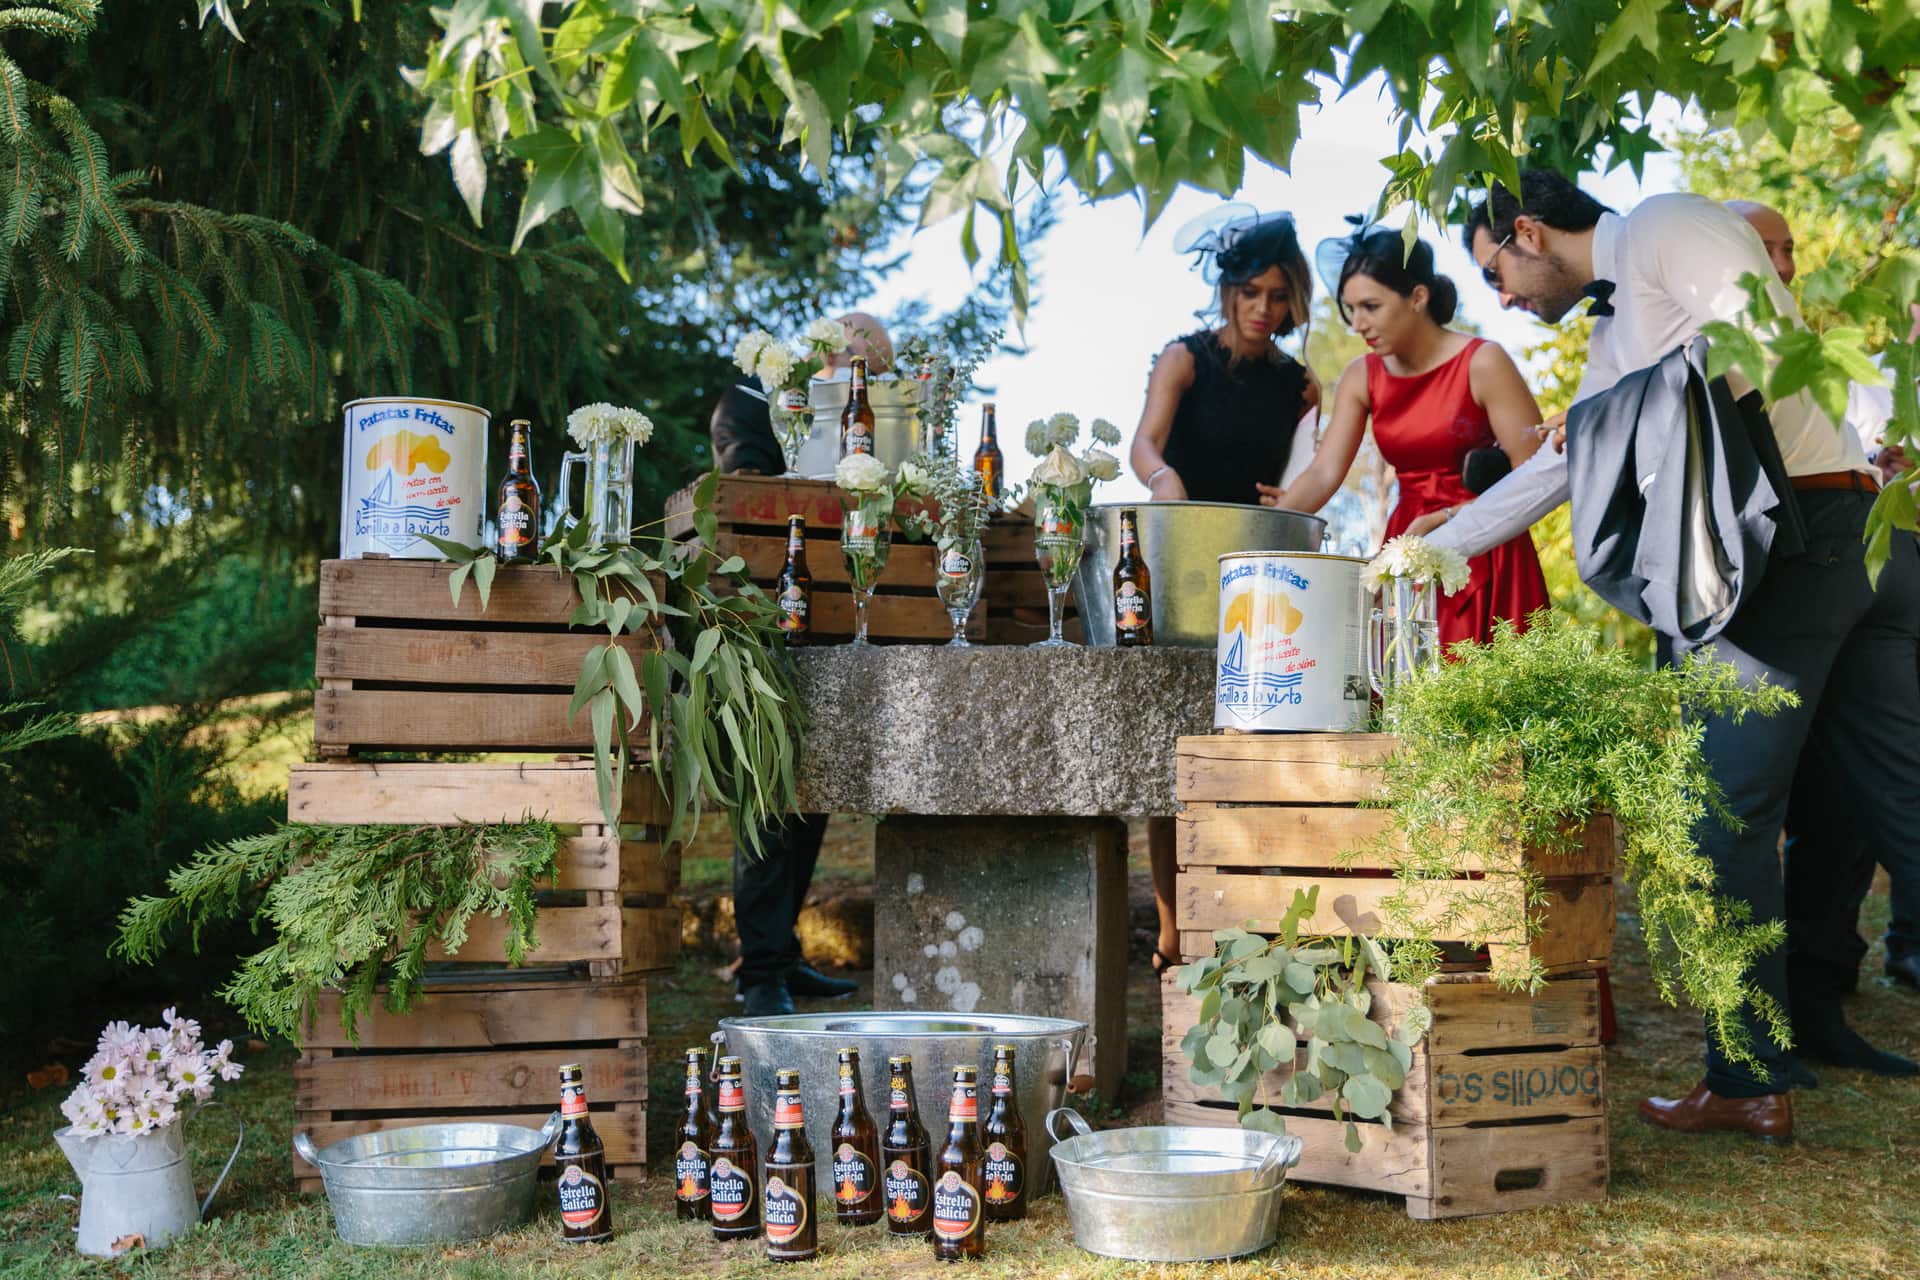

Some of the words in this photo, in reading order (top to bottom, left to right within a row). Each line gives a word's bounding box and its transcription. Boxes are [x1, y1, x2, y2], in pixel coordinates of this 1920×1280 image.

[359, 408, 409, 432] Patatas
[415, 408, 456, 434] Fritas
[500, 511, 529, 521] Estrella
[356, 510, 390, 536] Bonilla
[393, 524, 400, 535] a
[404, 516, 415, 535] la
[419, 520, 450, 536] vista
[1221, 564, 1258, 590] Patatas
[1263, 562, 1309, 590] Fritas
[1117, 596, 1144, 605] Estrella
[1242, 691, 1249, 703] a
[1253, 685, 1263, 703] la
[1266, 687, 1302, 705] vista
[1492, 1064, 1601, 1107] bordils
[676, 1159, 706, 1169] Estrella
[834, 1161, 865, 1172] Estrella
[985, 1161, 1015, 1171] strella
[677, 1168, 705, 1180] Galicia
[835, 1170, 864, 1184] Galicia
[711, 1178, 744, 1190] Estrella
[886, 1178, 918, 1189] Estrella
[560, 1185, 596, 1199] Estrella
[711, 1189, 742, 1202] Galicia
[887, 1188, 918, 1200] Galicia
[561, 1196, 595, 1211] Galicia
[935, 1192, 972, 1208] Estrella
[935, 1205, 969, 1220] Galicia
